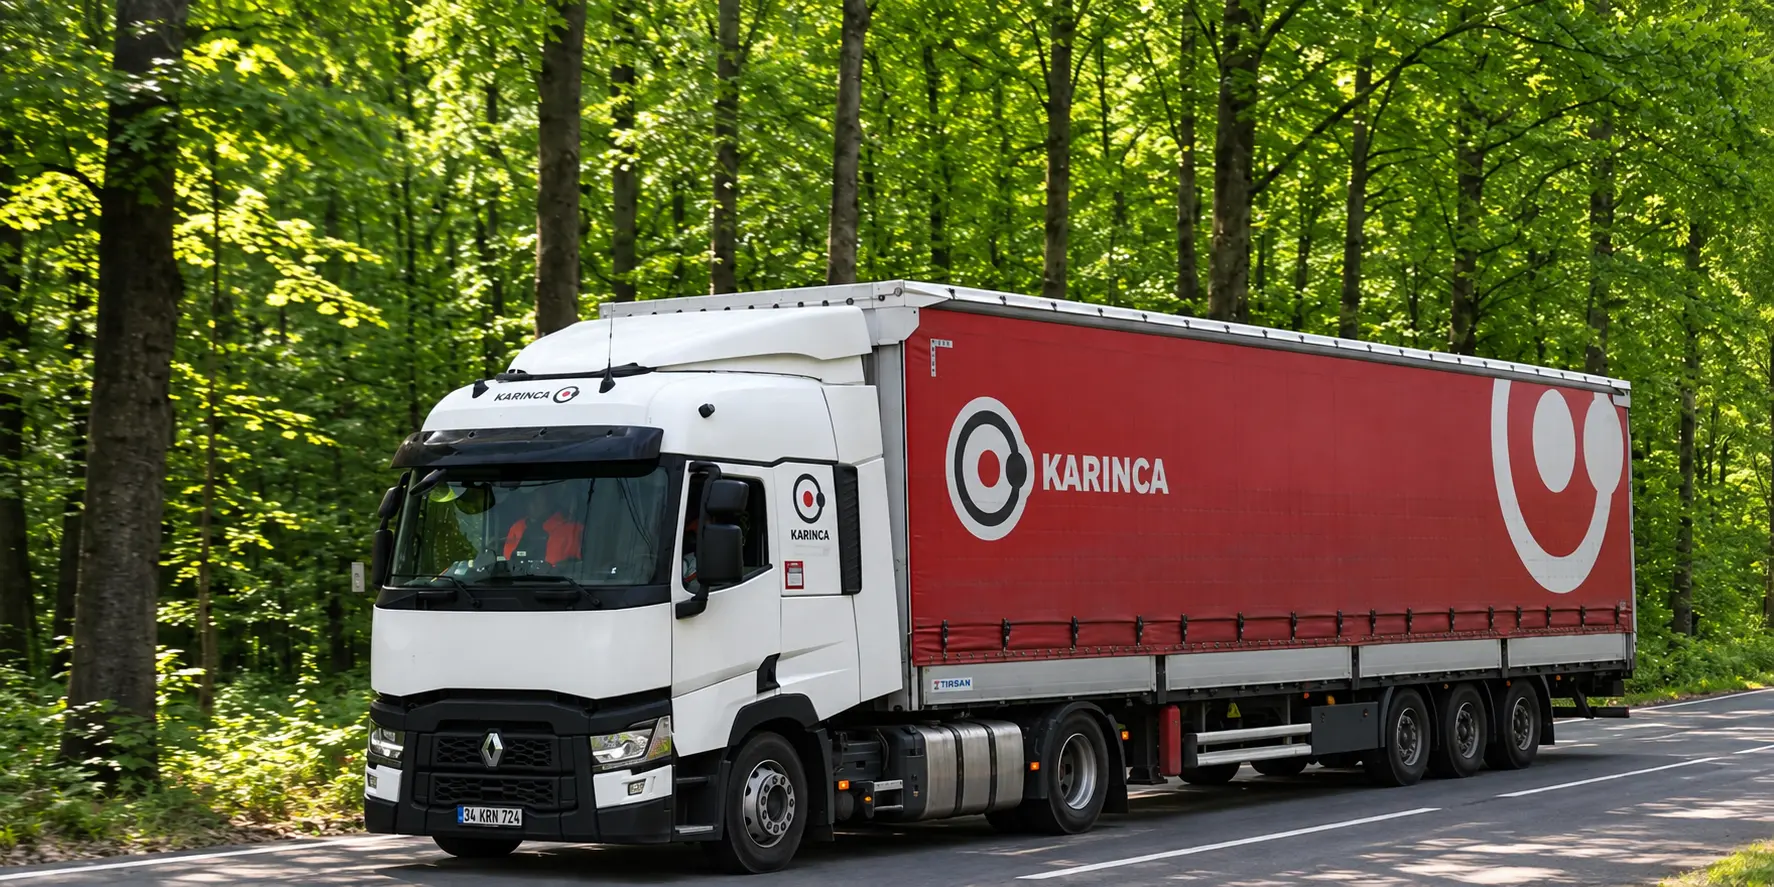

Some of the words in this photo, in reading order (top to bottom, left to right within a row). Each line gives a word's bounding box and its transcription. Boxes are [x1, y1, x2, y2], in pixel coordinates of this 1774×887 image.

[494, 391, 550, 402] KARINCA
[1042, 453, 1170, 495] KARINCA
[790, 529, 830, 541] KARINCA
[941, 679, 971, 688] TIRSAN
[464, 808, 476, 822] 34
[480, 808, 499, 823] KRN
[502, 809, 520, 824] 724
